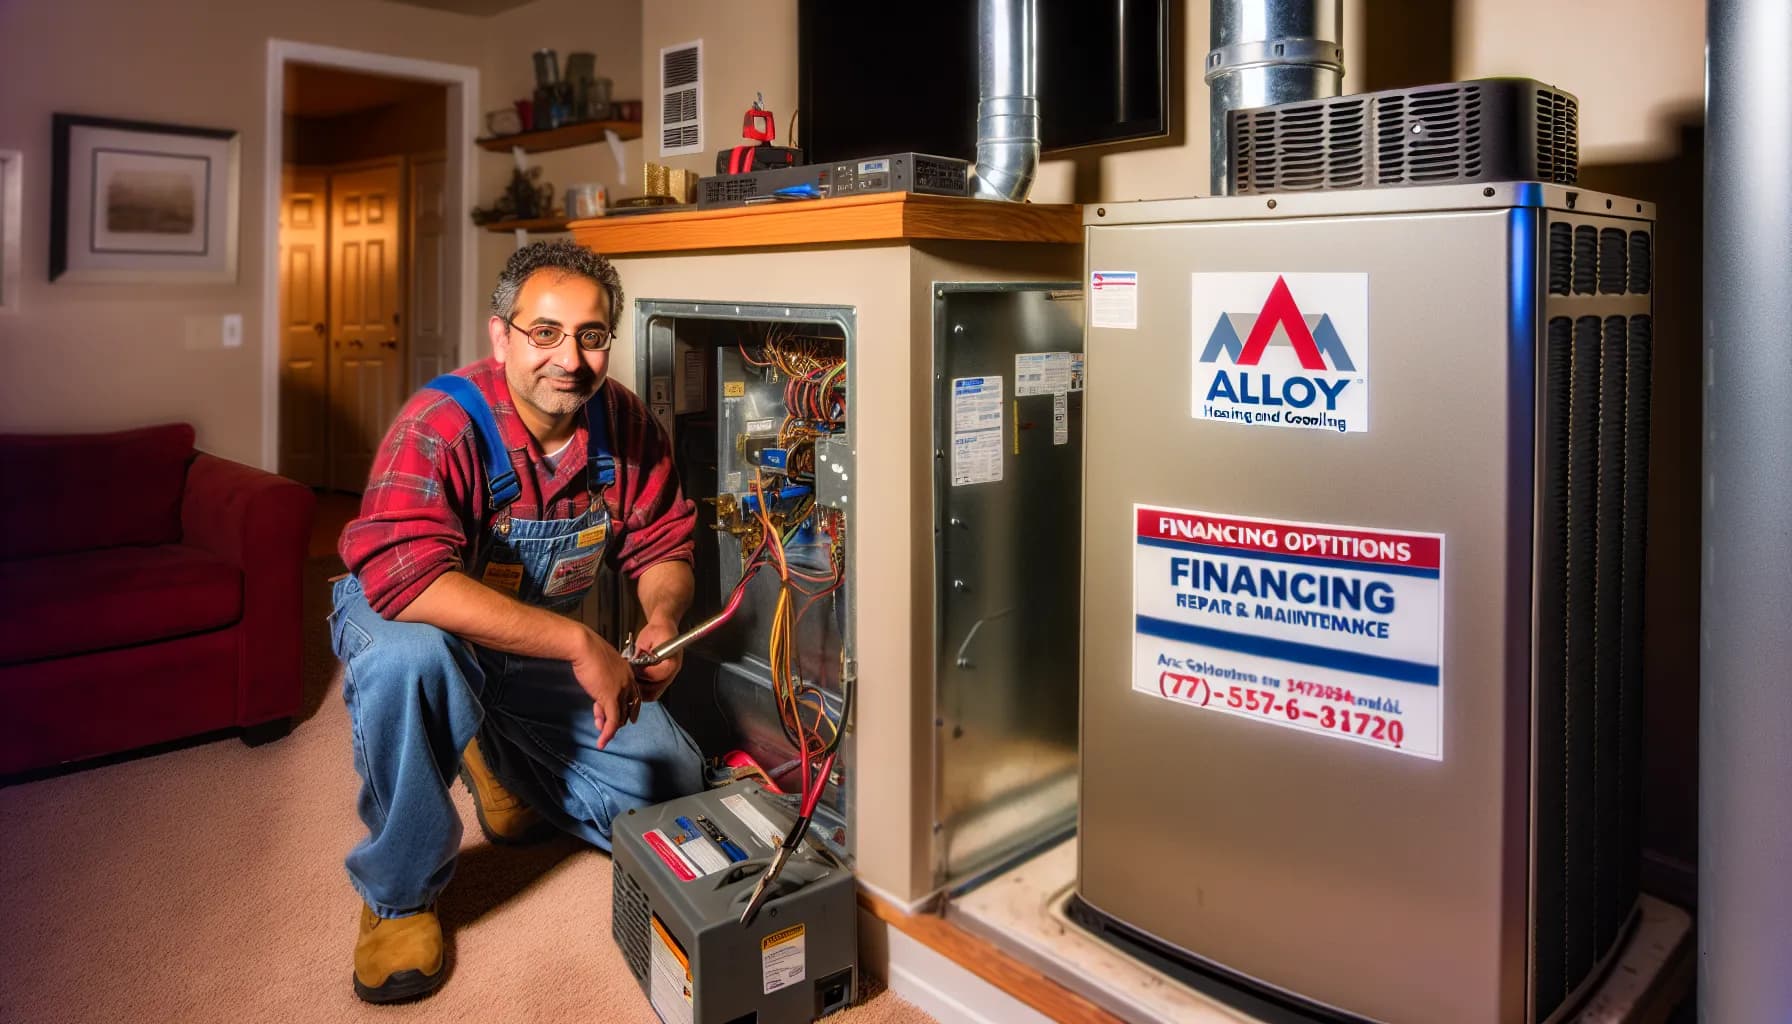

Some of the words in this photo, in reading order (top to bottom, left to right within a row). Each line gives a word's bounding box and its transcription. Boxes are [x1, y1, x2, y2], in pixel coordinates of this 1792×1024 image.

[1206, 369, 1351, 411] ALLOY
[1159, 516, 1278, 548] FINANCING
[1284, 531, 1412, 562] OPTITIONS
[1170, 556, 1395, 615] FINANCING
